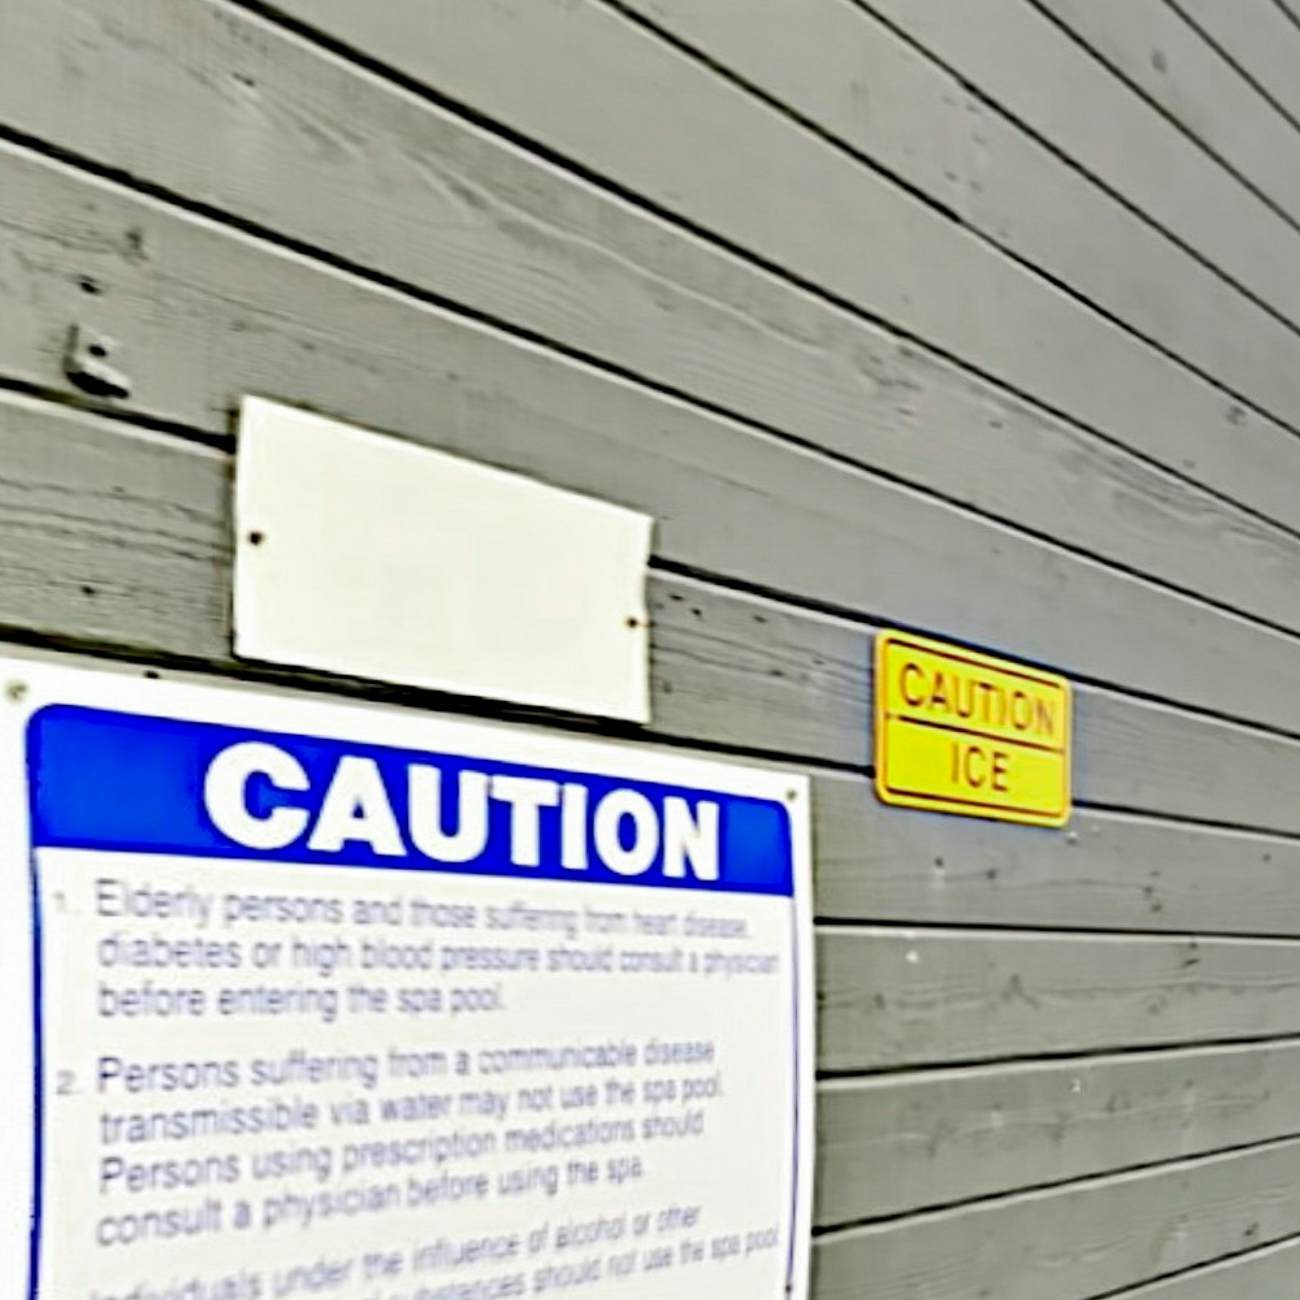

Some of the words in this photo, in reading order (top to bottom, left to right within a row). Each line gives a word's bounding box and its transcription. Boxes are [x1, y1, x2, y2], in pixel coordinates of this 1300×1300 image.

[900, 662, 1054, 735] CAUTION
[951, 743, 1010, 792] ICE
[203, 740, 721, 881] CAUTION
[95, 878, 210, 929] Elderly
[223, 891, 344, 927] persons
[351, 893, 401, 926] and
[410, 899, 476, 930] those
[485, 901, 579, 940] suffering
[584, 906, 626, 934] from
[98, 934, 242, 968] diabetes
[251, 939, 283, 968] or
[291, 936, 350, 977] high
[360, 939, 433, 970] blood
[440, 943, 540, 976] pressure
[547, 945, 613, 972] should
[619, 946, 683, 973] consult
[688, 950, 698, 972] a
[98, 981, 207, 1018] before
[217, 982, 338, 1024] entering
[346, 983, 389, 1014] the
[397, 985, 442, 1016] spa
[97, 1055, 240, 1095] Persons
[250, 1047, 378, 1090] suffering
[387, 1045, 446, 1079] from
[454, 1048, 470, 1077] a
[478, 1039, 637, 1075] communicable
[643, 1036, 716, 1067] disease
[98, 1097, 319, 1147] transmissible
[329, 1092, 371, 1126] via
[380, 1092, 452, 1124] water
[459, 1090, 509, 1123] may
[517, 1085, 554, 1112] not
[560, 1081, 598, 1110] use
[604, 1076, 636, 1105] the
[642, 1077, 677, 1110] spa
[98, 1154, 242, 1197] Persons
[252, 1144, 332, 1184] using
[341, 1129, 497, 1174] prescription
[505, 1117, 636, 1153] medications
[642, 1110, 705, 1139] should
[96, 1194, 224, 1247] consult
[231, 1200, 253, 1230] a
[262, 1181, 401, 1230] physician
[407, 1167, 489, 1207] before
[498, 1161, 560, 1198] using
[565, 1156, 601, 1184] the
[272, 1257, 355, 1294] under
[362, 1250, 403, 1281] the
[412, 1235, 520, 1274] influence
[527, 1222, 550, 1257] of
[556, 1212, 627, 1250] alcohol
[632, 1212, 651, 1236] or
[657, 1204, 702, 1233] other
[533, 1257, 601, 1294] should
[607, 1252, 637, 1279] not
[643, 1245, 673, 1272] use
[679, 1239, 705, 1264] the
[711, 1233, 740, 1261] spa
